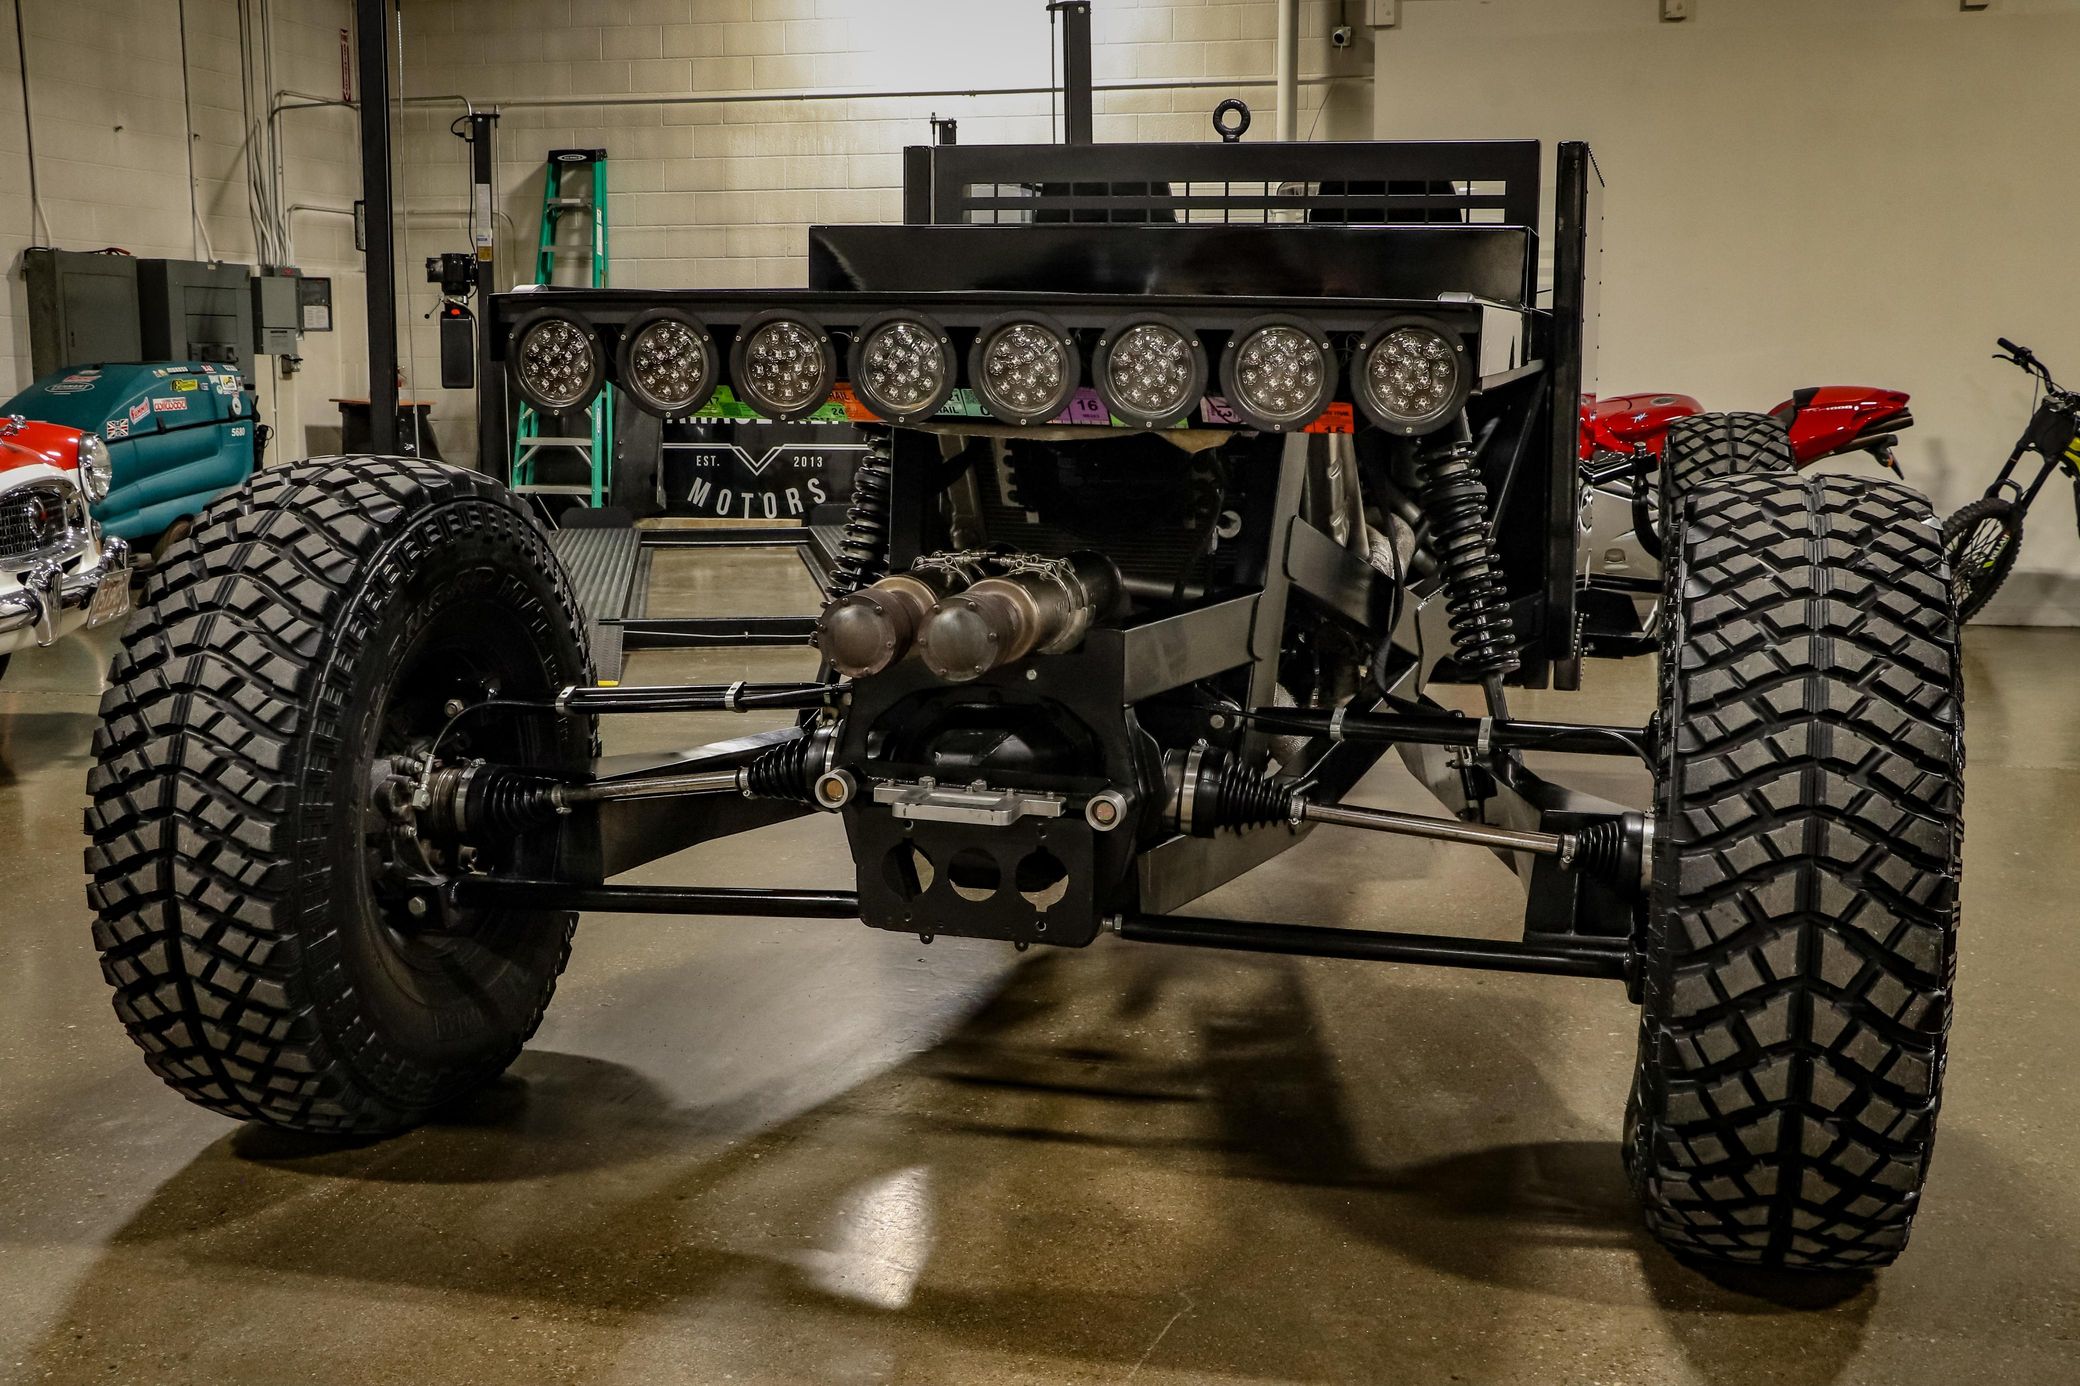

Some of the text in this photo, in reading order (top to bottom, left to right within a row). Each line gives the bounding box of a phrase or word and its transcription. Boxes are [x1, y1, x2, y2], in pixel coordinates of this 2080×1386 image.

[1077, 399, 1099, 411] 16
[831, 407, 845, 416] 24
[696, 455, 824, 468] EST. 2013
[687, 476, 827, 519] MOTORS
